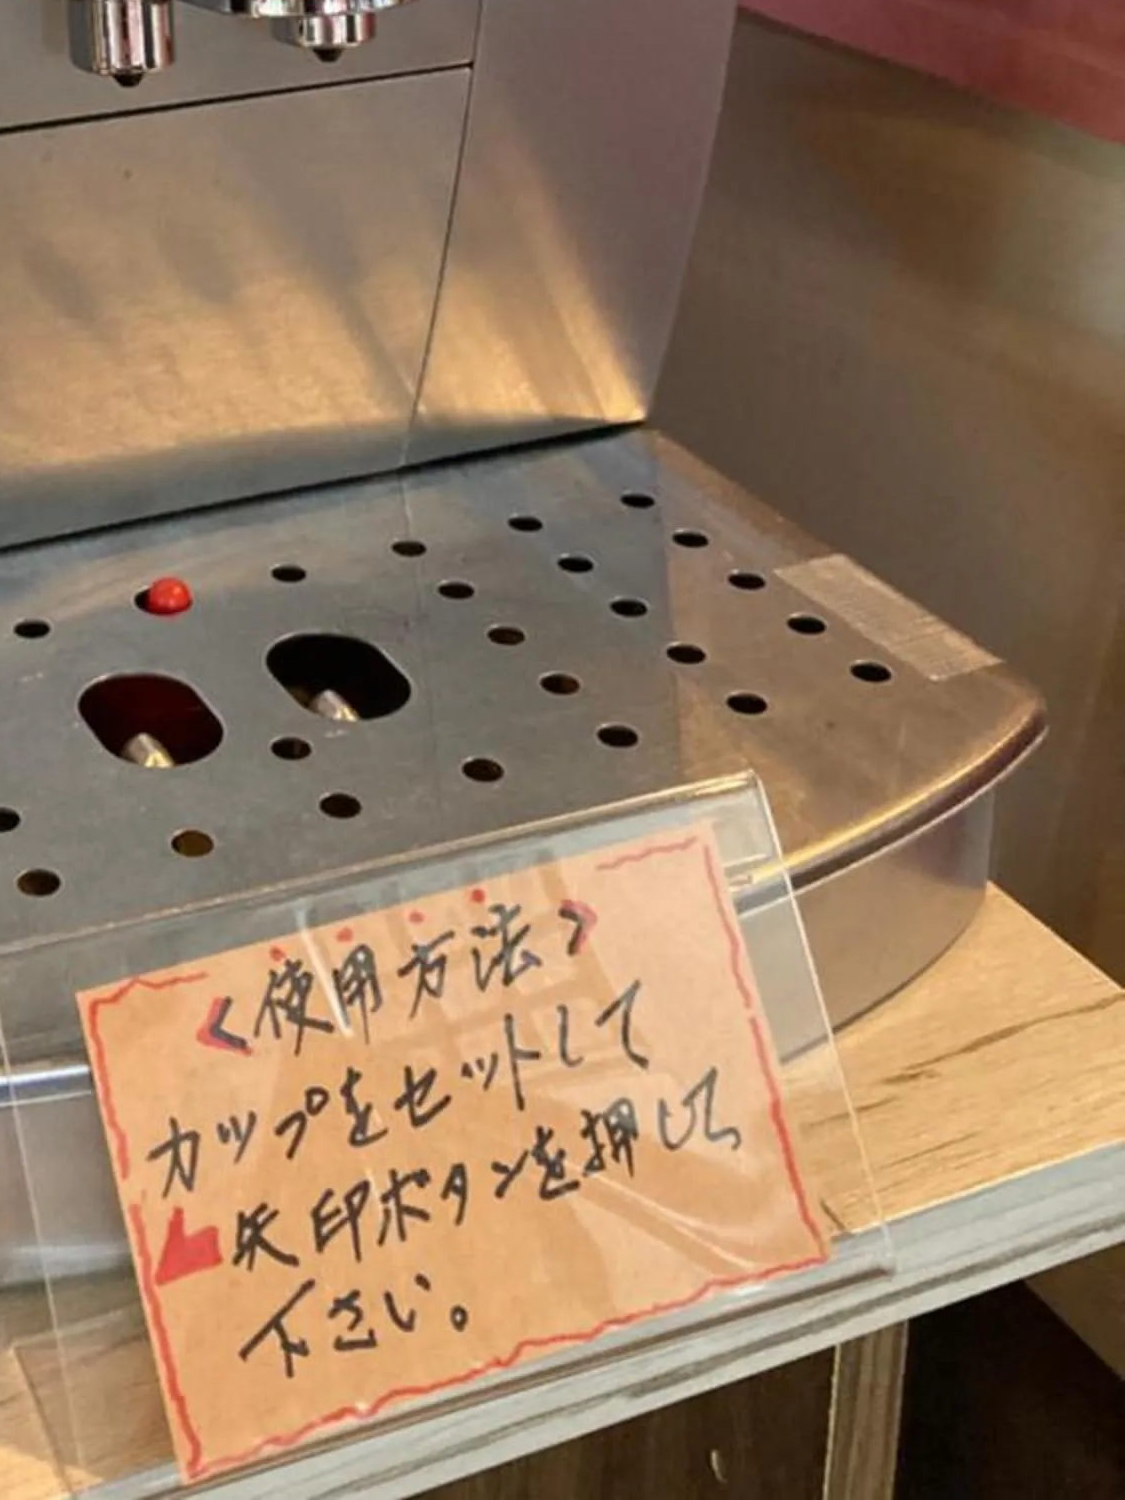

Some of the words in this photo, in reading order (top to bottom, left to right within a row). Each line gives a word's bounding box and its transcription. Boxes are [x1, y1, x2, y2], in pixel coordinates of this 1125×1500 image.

[147, 980, 651, 1199] カップをセットして
[231, 1067, 742, 1273] 矢印ボタンを押して
[240, 1275, 469, 1378] 下さい。
